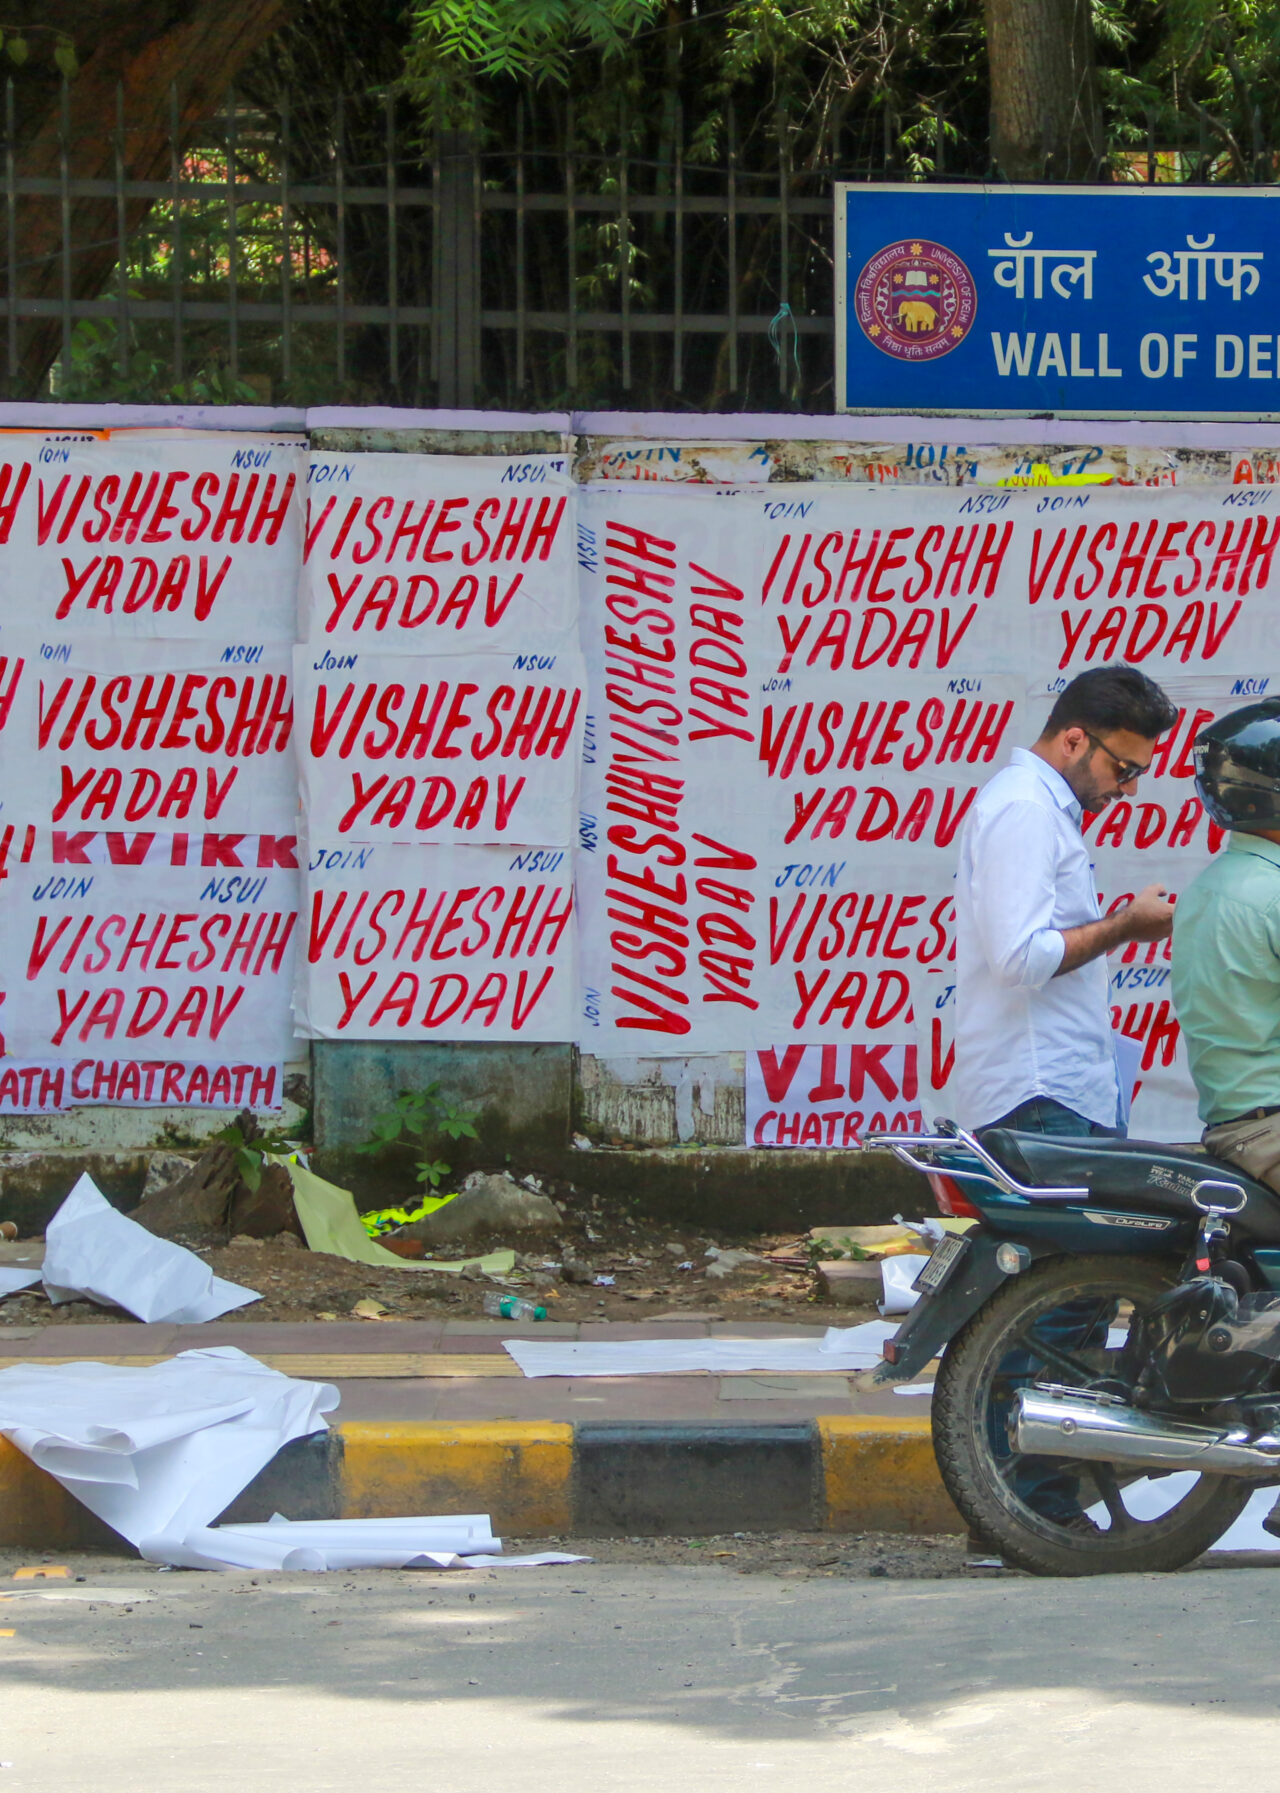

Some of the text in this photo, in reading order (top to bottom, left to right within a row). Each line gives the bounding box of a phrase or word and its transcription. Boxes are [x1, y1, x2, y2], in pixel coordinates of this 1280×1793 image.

[931, 248, 971, 323] UNIVERSITY OF DELHI
[988, 231, 1097, 299] वॉल
[1142, 233, 1263, 301] ऑफ
[990, 332, 1123, 378] WALL
[1139, 333, 1198, 379] OF
[230, 450, 271, 469] NSUI
[307, 463, 356, 483] JOIN
[37, 470, 296, 546] VISHESHH
[304, 496, 567, 566] VISHESHH
[958, 495, 1011, 514] NSUI
[1037, 490, 1272, 512] JOIN NSUI
[577, 523, 598, 574] NSUI
[55, 554, 232, 621] YADAV
[324, 572, 524, 632] YADAV
[219, 644, 264, 664] NSUI
[313, 651, 557, 672] JOIN NSUI
[688, 561, 755, 742] YADAV
[777, 603, 978, 674] YADAV
[1059, 600, 1242, 670] YADAV
[38, 674, 293, 756] VISHESHH
[762, 678, 982, 694] JOIN NSUI
[1230, 678, 1269, 695] NSUI
[309, 680, 582, 761] VISHESHH
[759, 699, 1014, 779] VISHESHH
[51, 765, 239, 823] YADAV
[337, 772, 527, 833] YADAV
[783, 787, 979, 847] YADAV
[33, 876, 268, 903] JOIN NSUI
[307, 847, 564, 874] JOIN NSUI
[775, 861, 843, 888] JOIN
[307, 884, 573, 966] VISHESHH
[604, 763, 691, 1035] VISHESHH
[691, 832, 760, 1011] YADAV
[770, 892, 956, 965] VISHES
[26, 912, 298, 981] VISHESHH
[337, 966, 555, 1030] YADAV
[793, 968, 914, 1029] YAD
[1111, 967, 1171, 989] NSUI
[50, 984, 246, 1047] YADAV
[70, 1058, 276, 1108] CHATRAATH
